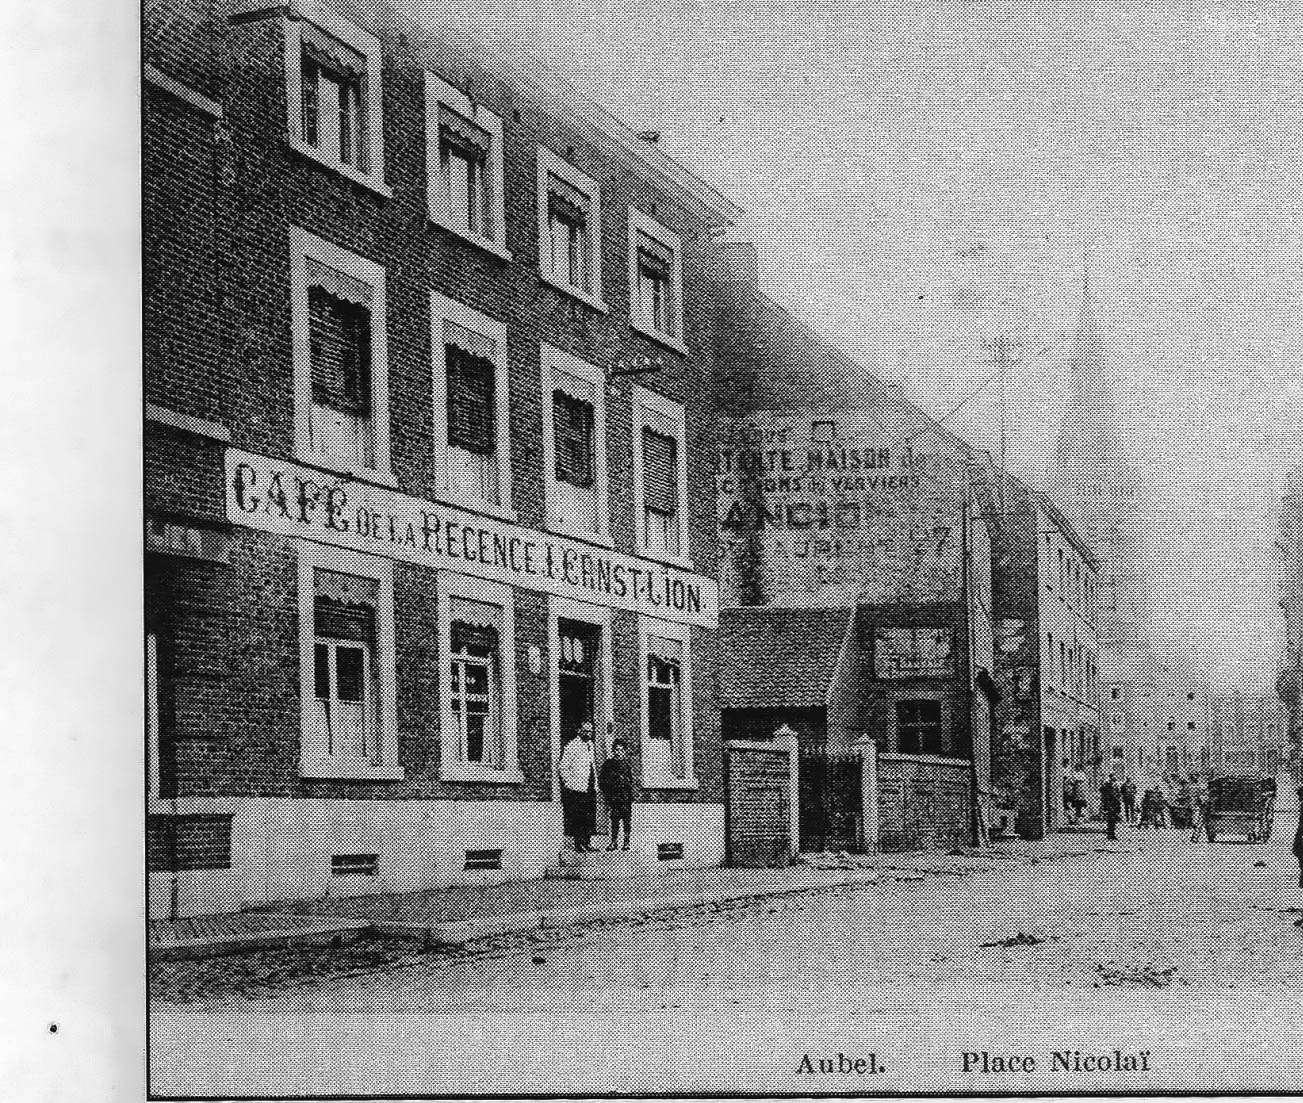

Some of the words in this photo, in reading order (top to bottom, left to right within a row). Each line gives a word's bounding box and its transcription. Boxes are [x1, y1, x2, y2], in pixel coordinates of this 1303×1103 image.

[806, 448, 891, 471] MAISON
[355, 506, 384, 541] DE
[388, 513, 417, 549] LA
